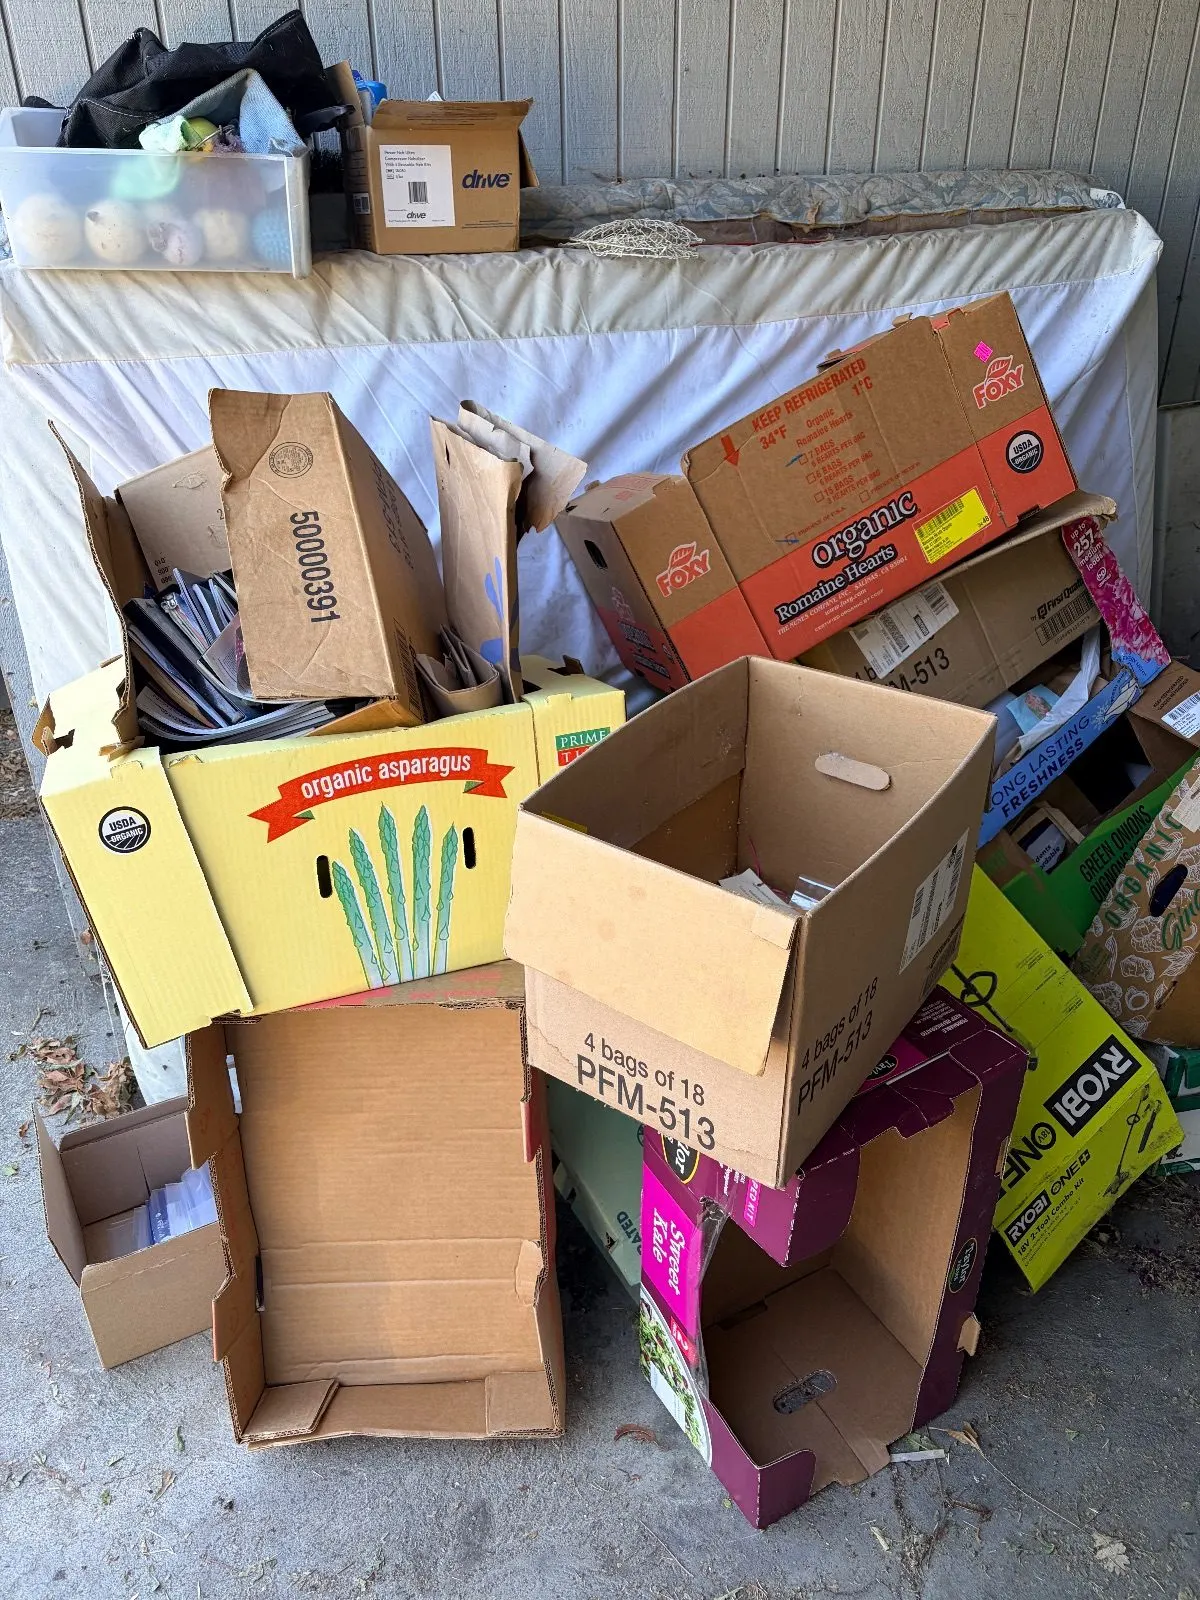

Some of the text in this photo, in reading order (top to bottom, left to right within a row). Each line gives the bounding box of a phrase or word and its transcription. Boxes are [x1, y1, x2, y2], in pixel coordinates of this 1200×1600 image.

[462, 170, 510, 188] drive
[407, 211, 426, 219] drive
[752, 358, 867, 432] KEEP REFRIGERATED
[972, 364, 1024, 409] FOXY
[796, 410, 853, 448] Romaine Hearts
[806, 408, 835, 428] Organic
[815, 439, 836, 456] BAGS
[822, 459, 843, 474] BAGS
[1012, 439, 1033, 455] USDA
[1014, 447, 1039, 465] ORGANIC
[834, 475, 854, 491] BAGS
[1070, 522, 1086, 540] up to
[1073, 528, 1097, 558] 257
[289, 509, 340, 624] 50000391
[656, 549, 711, 598] FOXY
[1079, 541, 1103, 567] medium
[1086, 554, 1104, 572] loads
[776, 575, 846, 622] Romaine
[844, 546, 895, 582] Hearts
[1047, 593, 1064, 611] First
[1063, 578, 1084, 599] Quali
[886, 647, 950, 692] M-513
[561, 731, 606, 749] PRIME
[562, 751, 577, 766] TI
[1029, 715, 1090, 773] LASTING
[301, 753, 471, 800] organic asparagus
[1002, 738, 1084, 818] FRESHNESS
[109, 816, 137, 832] USDA
[110, 827, 144, 843] ORGANIC
[1079, 805, 1151, 883] GREEN ONIONS
[1035, 845, 1051, 862] dents
[1105, 811, 1183, 928] ORGANIC
[801, 977, 878, 1070] 4 bags of 18
[584, 1032, 705, 1107] 4 bags of 18
[797, 1009, 873, 1116] PFM-513
[870, 1059, 895, 1076] Tayl
[577, 1053, 716, 1150] PFM-513
[1053, 1045, 1133, 1126] RYOBI
[1037, 1130, 1051, 1144] 18V
[745, 1180, 759, 1222] PED KIT
[1009, 1197, 1048, 1242] RYOBI
[1017, 1177, 1085, 1258] 18V 2-Tool Combo Kit
[652, 1207, 668, 1264] Kale
[668, 1220, 686, 1296] Sweet
